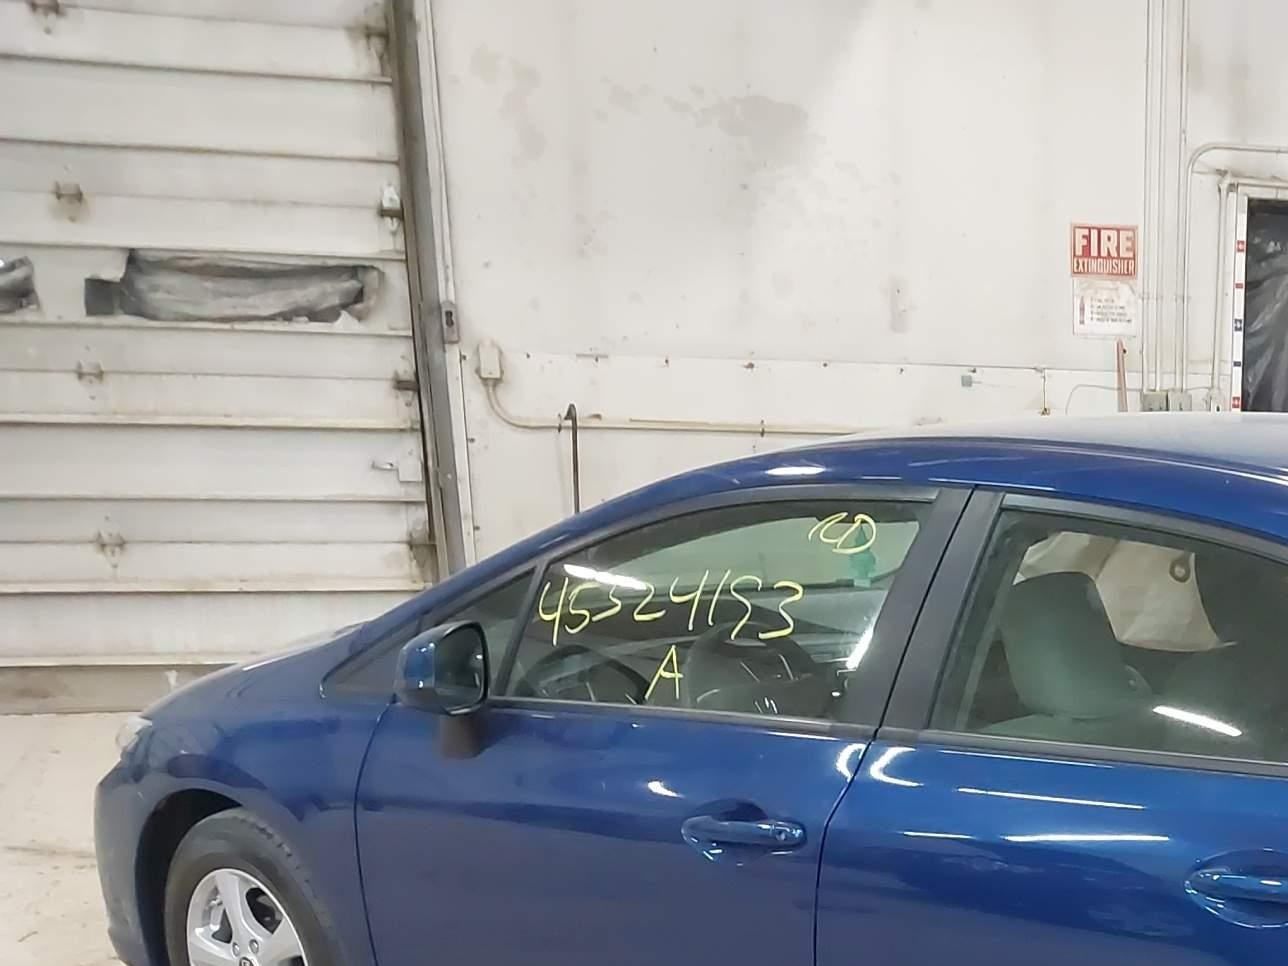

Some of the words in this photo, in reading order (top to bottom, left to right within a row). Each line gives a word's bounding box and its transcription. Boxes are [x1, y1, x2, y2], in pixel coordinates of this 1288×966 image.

[1074, 227, 1135, 258] FIRE
[1073, 257, 1136, 276] EXTINGUISHER
[645, 644, 684, 700] A
